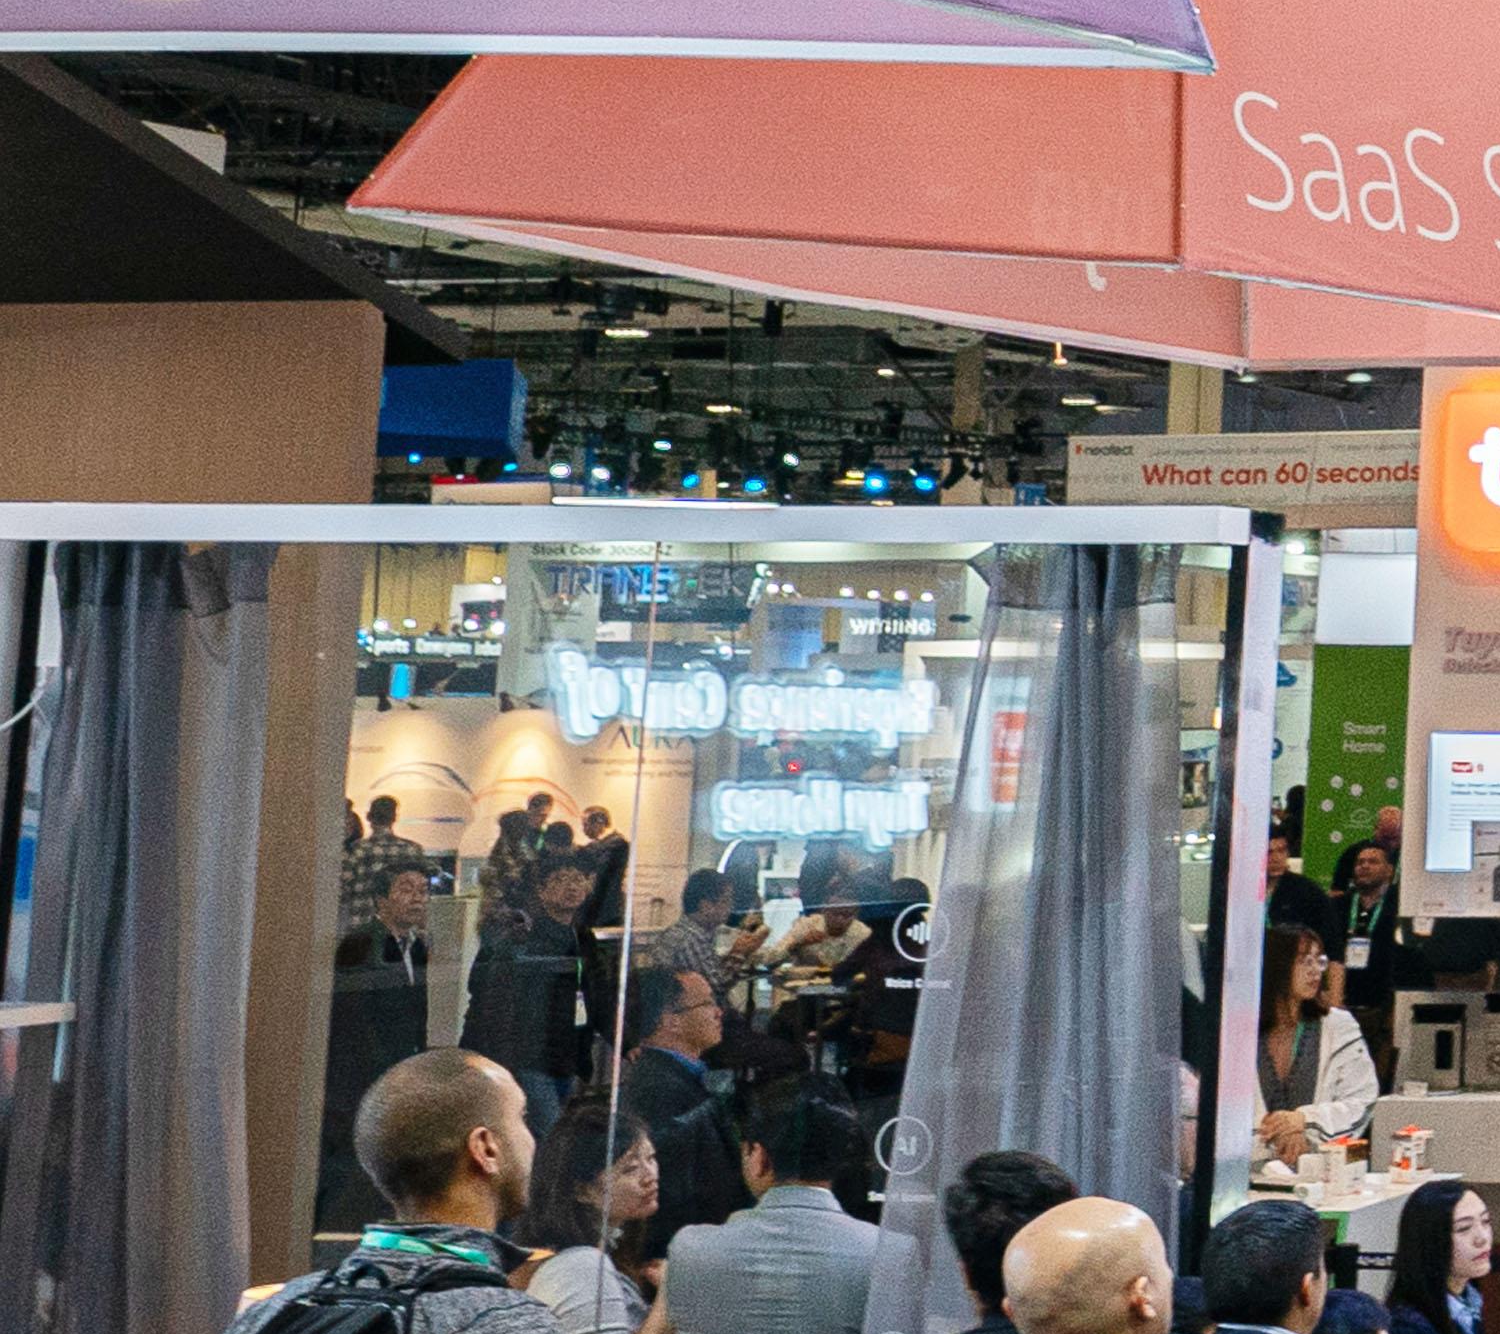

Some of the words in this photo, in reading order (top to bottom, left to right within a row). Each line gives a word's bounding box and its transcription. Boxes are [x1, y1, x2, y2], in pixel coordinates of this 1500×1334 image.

[1232, 90, 1459, 242] SaaS
[1141, 464, 1213, 486] What
[1220, 466, 1267, 486] can
[1276, 462, 1309, 485] 60
[1315, 461, 1421, 485] seconds
